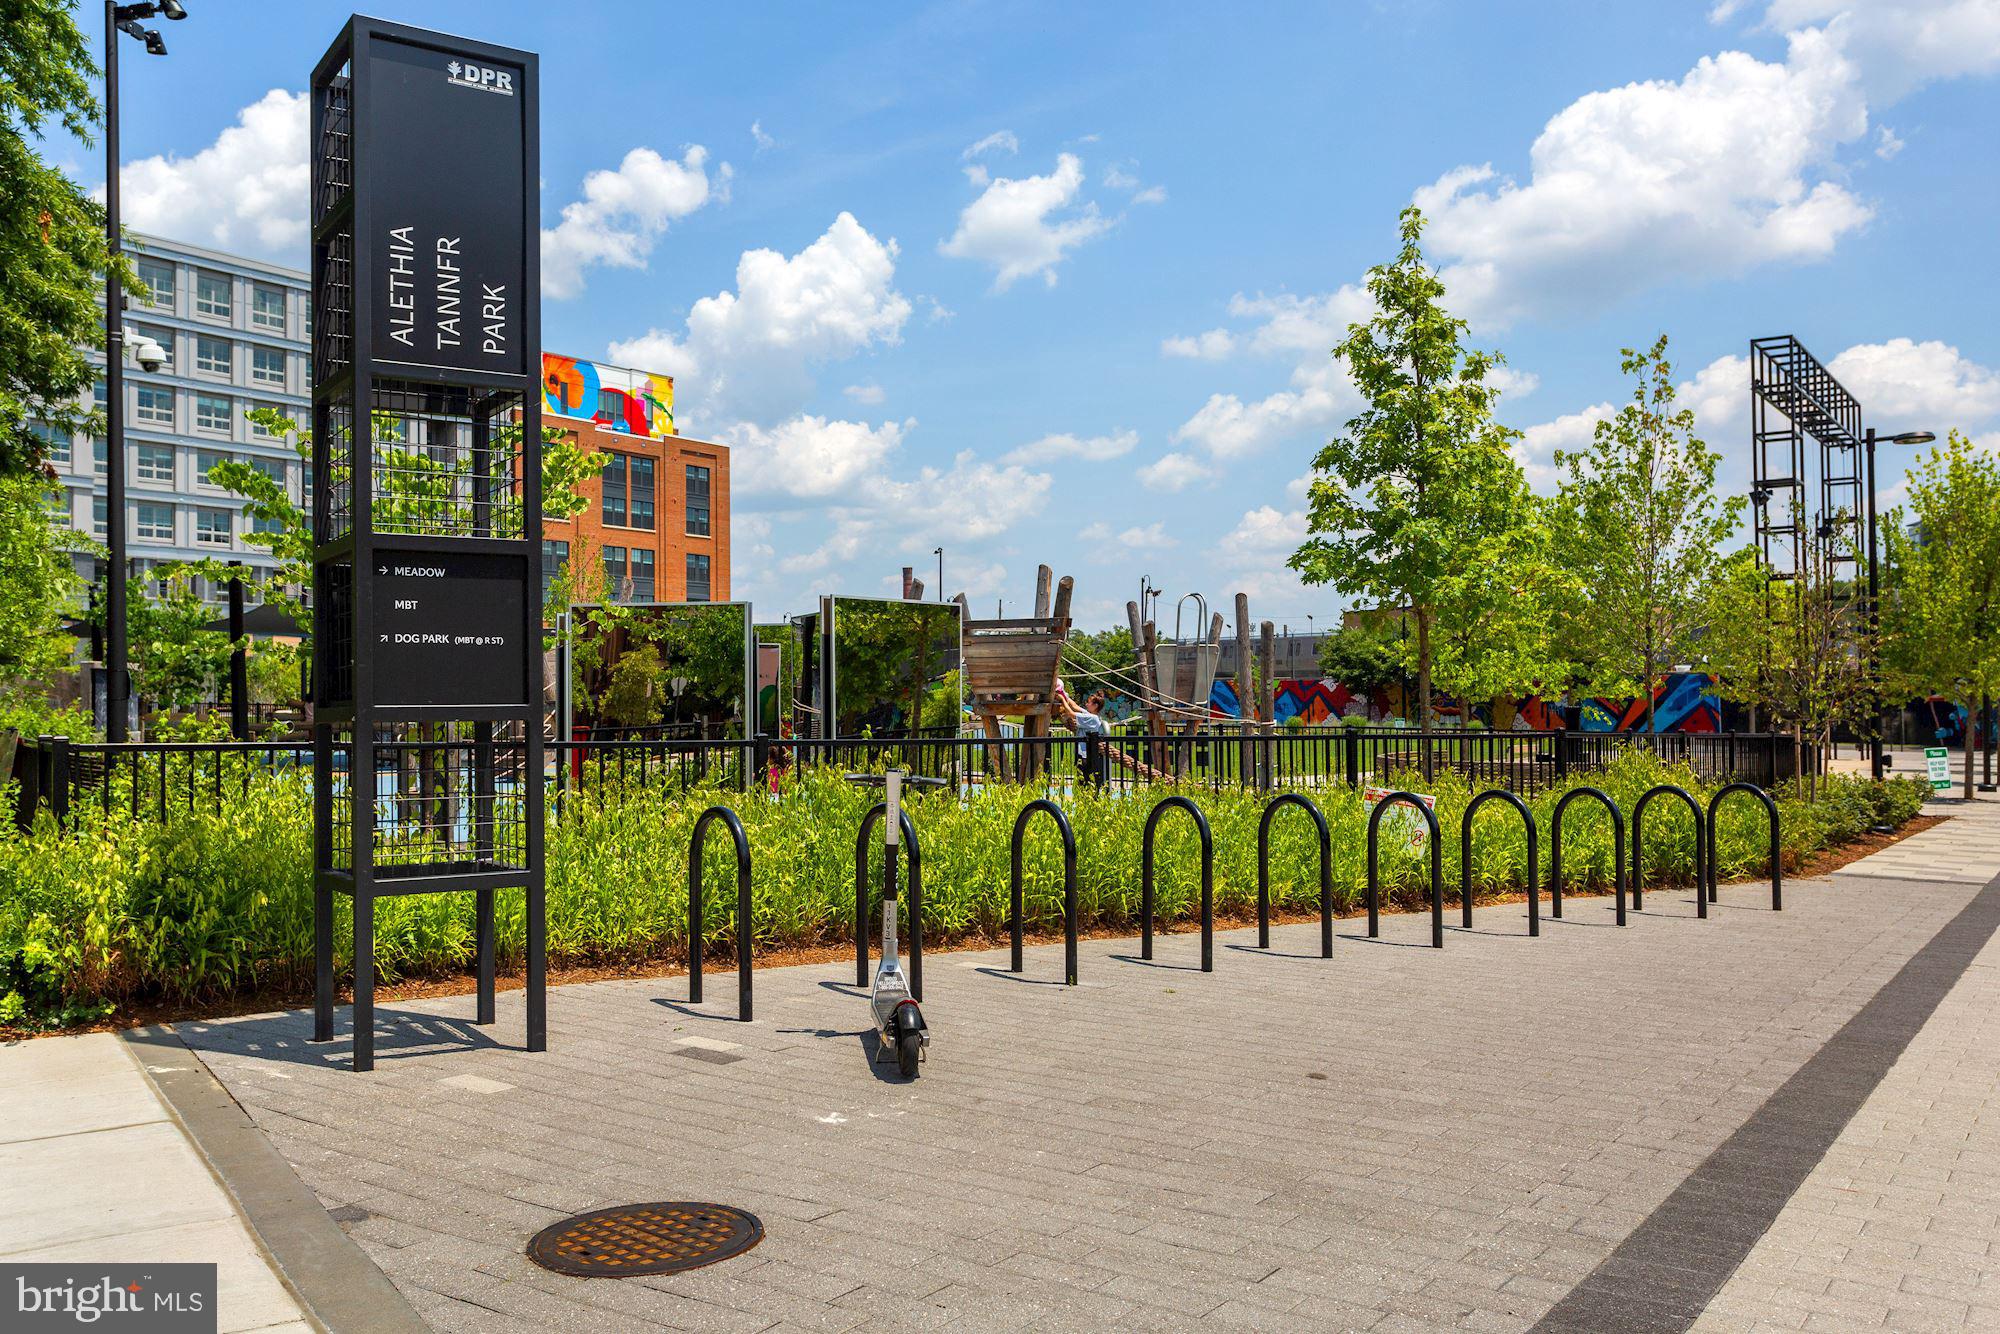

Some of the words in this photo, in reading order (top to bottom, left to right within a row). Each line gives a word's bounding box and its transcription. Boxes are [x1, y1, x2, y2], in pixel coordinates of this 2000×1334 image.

[464, 64, 513, 90] DPR
[390, 226, 414, 347] ALETHIA
[483, 283, 505, 355] PARK
[394, 566, 446, 577] MEADOW
[394, 600, 418, 610] MBT
[394, 633, 420, 643] DOG
[422, 633, 450, 644] PARK
[454, 636, 475, 645] (MBT
[475, 637, 483, 646] @
[484, 636, 490, 644] R
[491, 636, 504, 646] ST)
